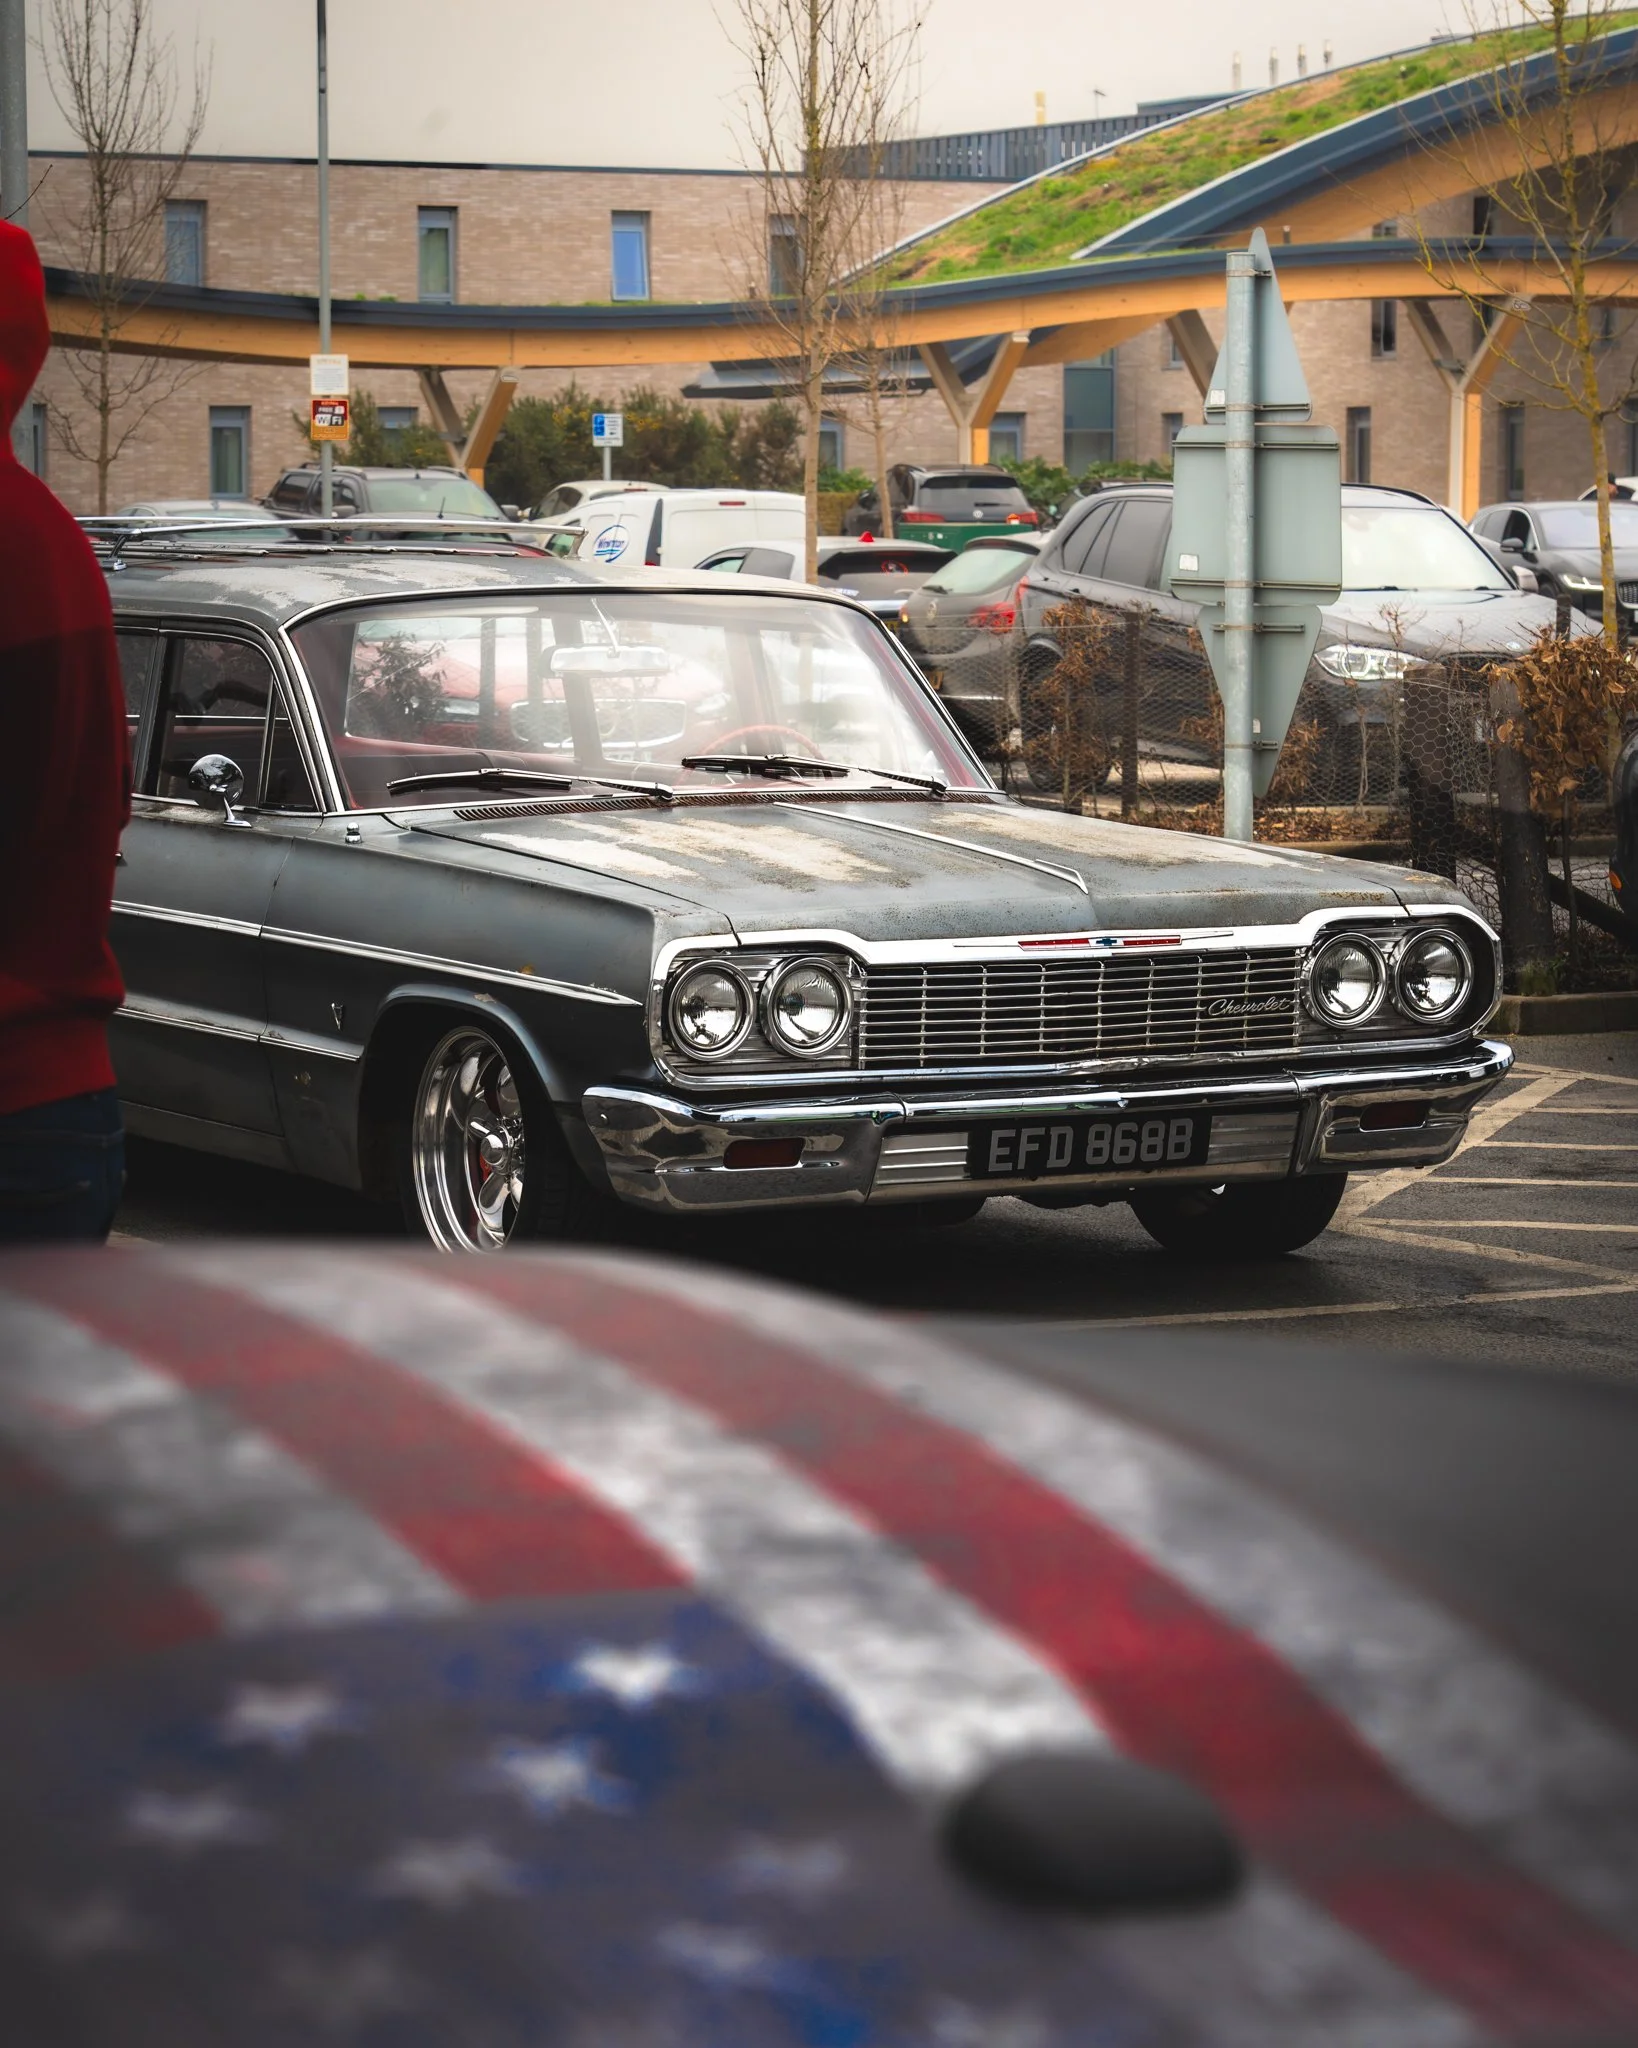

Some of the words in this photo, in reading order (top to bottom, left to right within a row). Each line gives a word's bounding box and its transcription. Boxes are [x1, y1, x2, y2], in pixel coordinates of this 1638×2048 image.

[1207, 996, 1291, 1016] Chevrolet
[988, 1126, 1074, 1172] EFD
[1085, 1118, 1194, 1165] 868B
